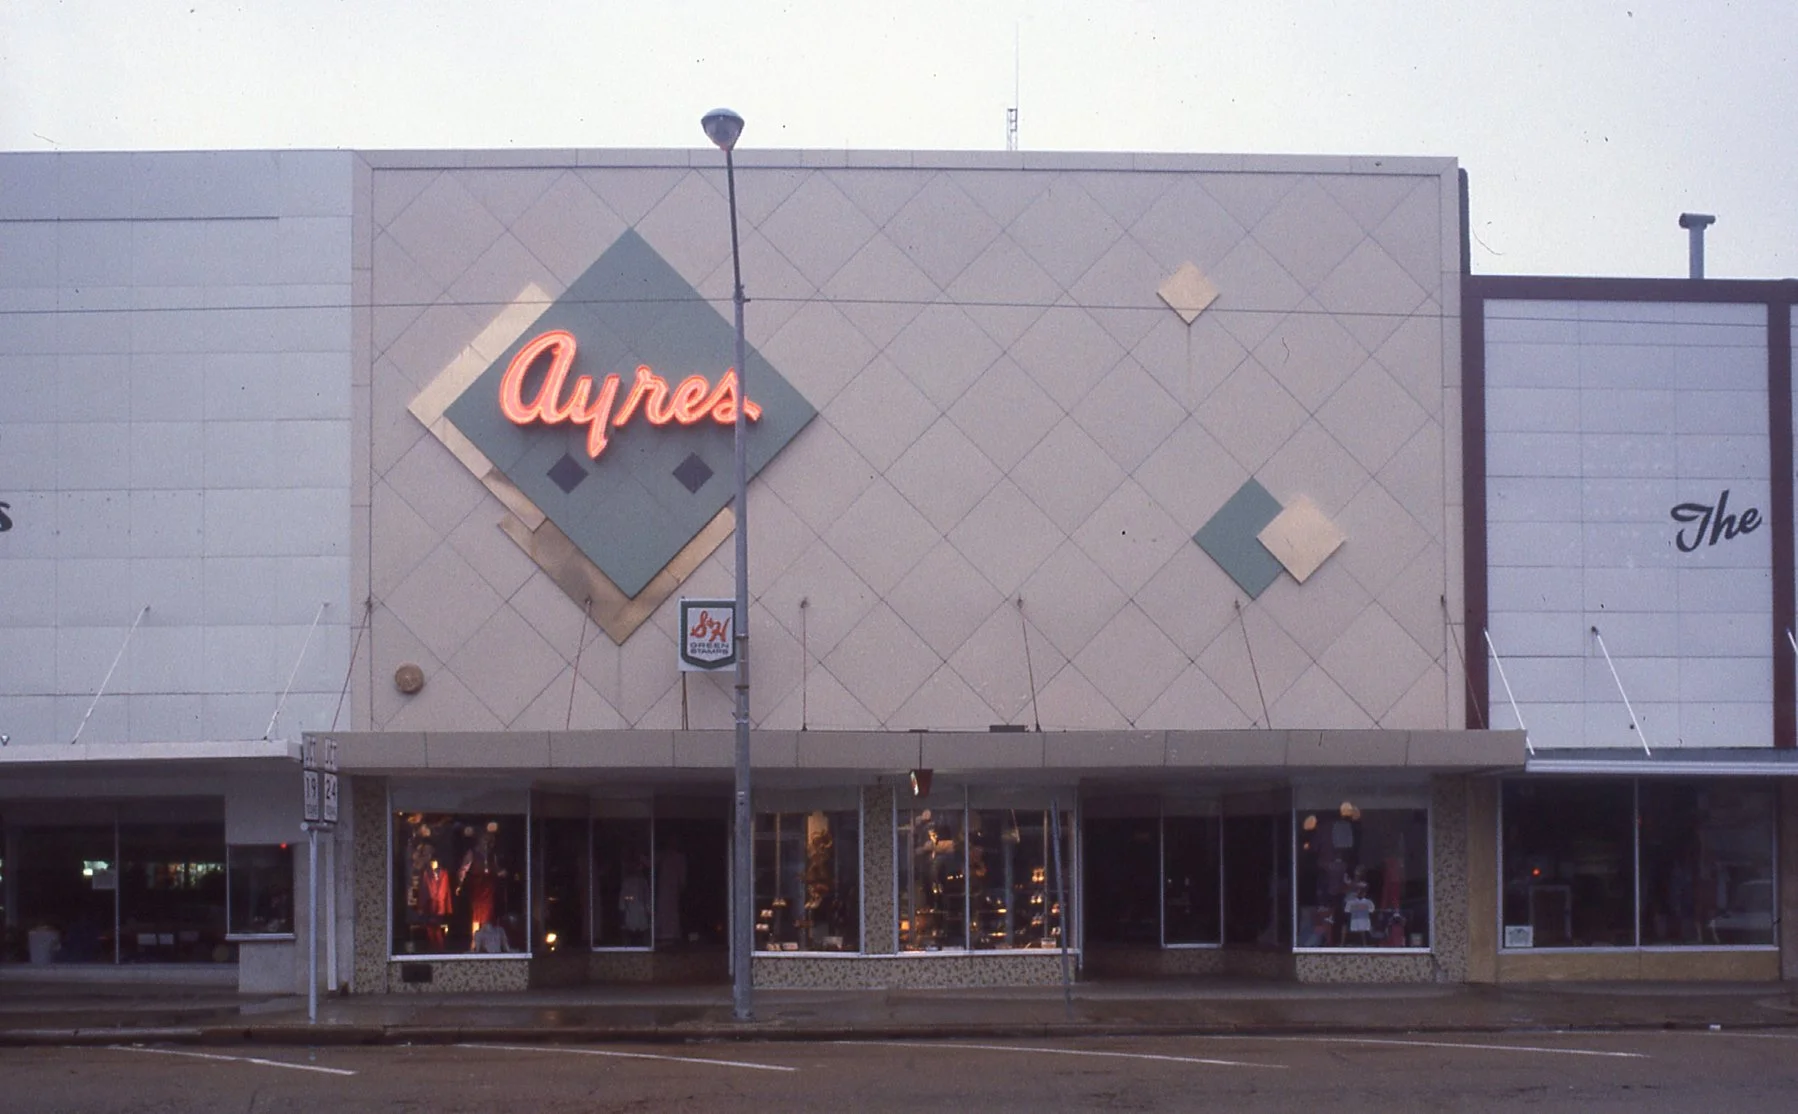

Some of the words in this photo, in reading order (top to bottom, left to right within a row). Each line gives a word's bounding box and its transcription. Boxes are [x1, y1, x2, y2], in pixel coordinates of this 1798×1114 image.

[499, 329, 763, 459] Ayres
[1670, 489, 1762, 552] The
[690, 610, 731, 642] S&H
[306, 777, 316, 798] 19
[326, 779, 336, 799] 24
